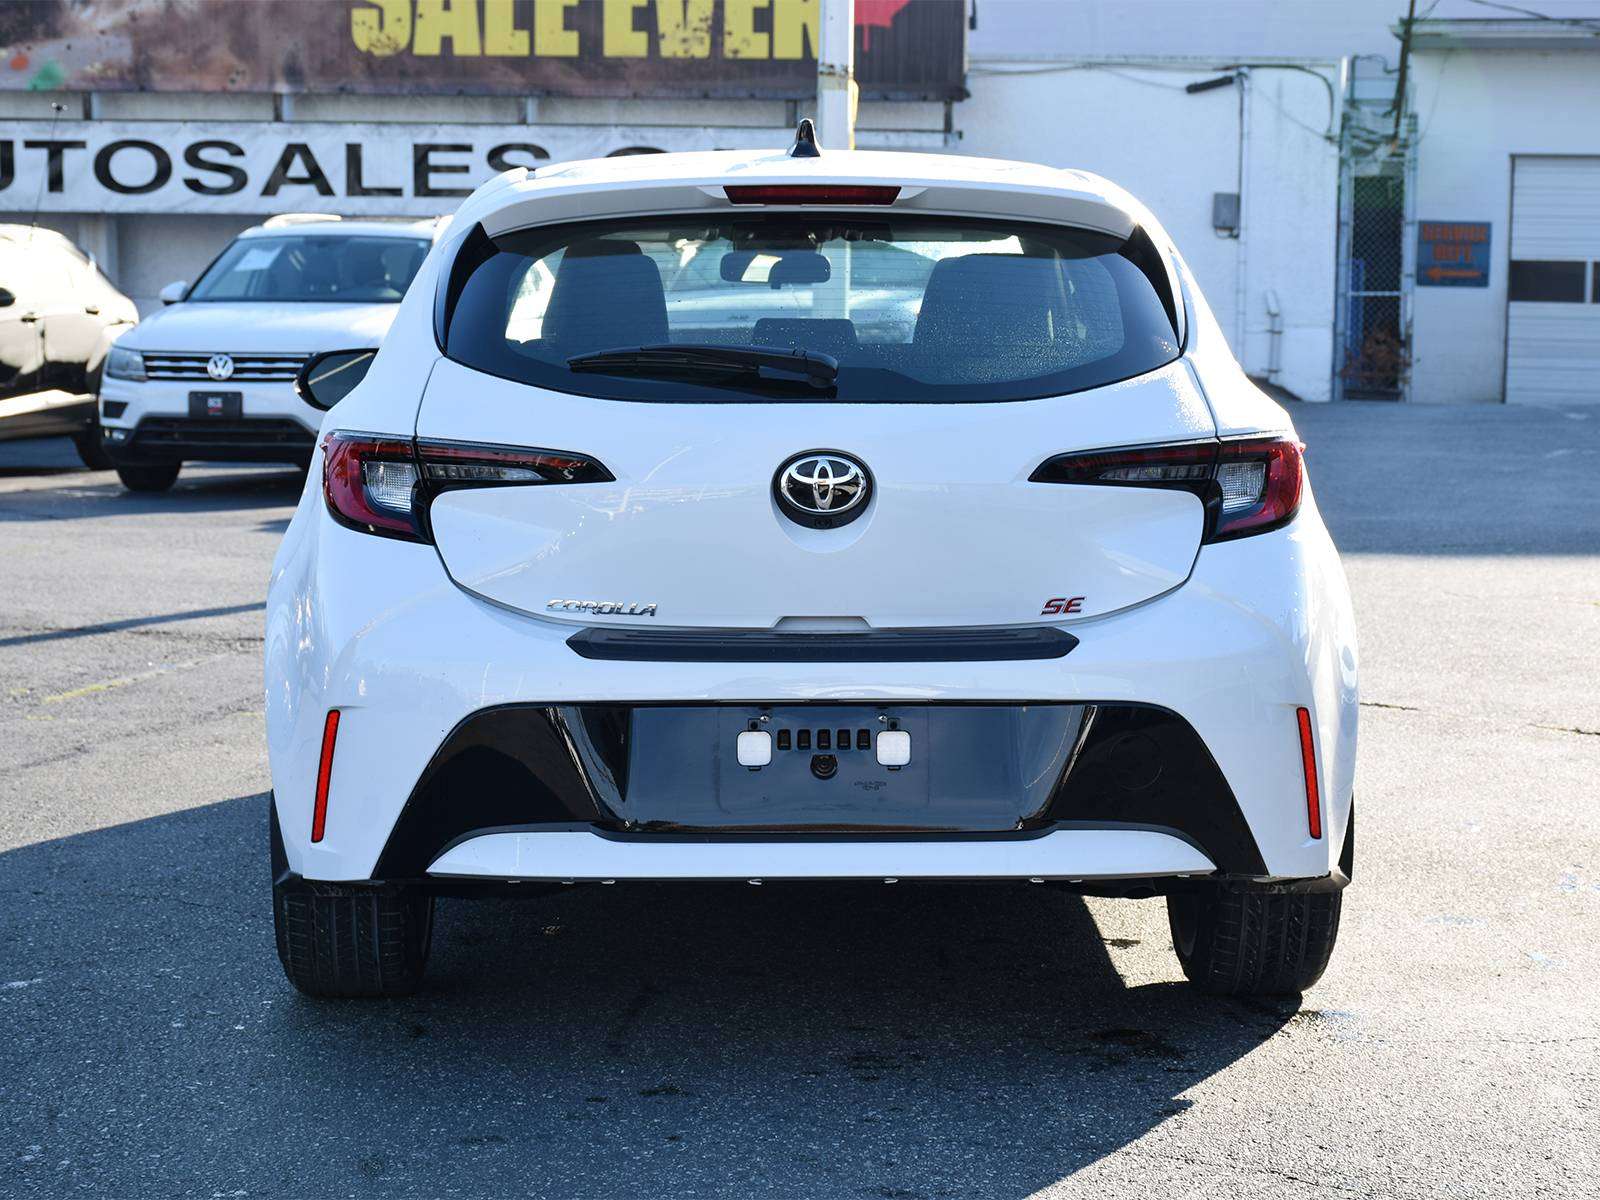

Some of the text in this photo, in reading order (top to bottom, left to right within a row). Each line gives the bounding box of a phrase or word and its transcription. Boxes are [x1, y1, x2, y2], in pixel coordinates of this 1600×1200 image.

[351, 0, 579, 57] SALE
[0, 139, 551, 198] TOSALES
[547, 599, 657, 617] COROLLA
[1041, 597, 1085, 615] SE
